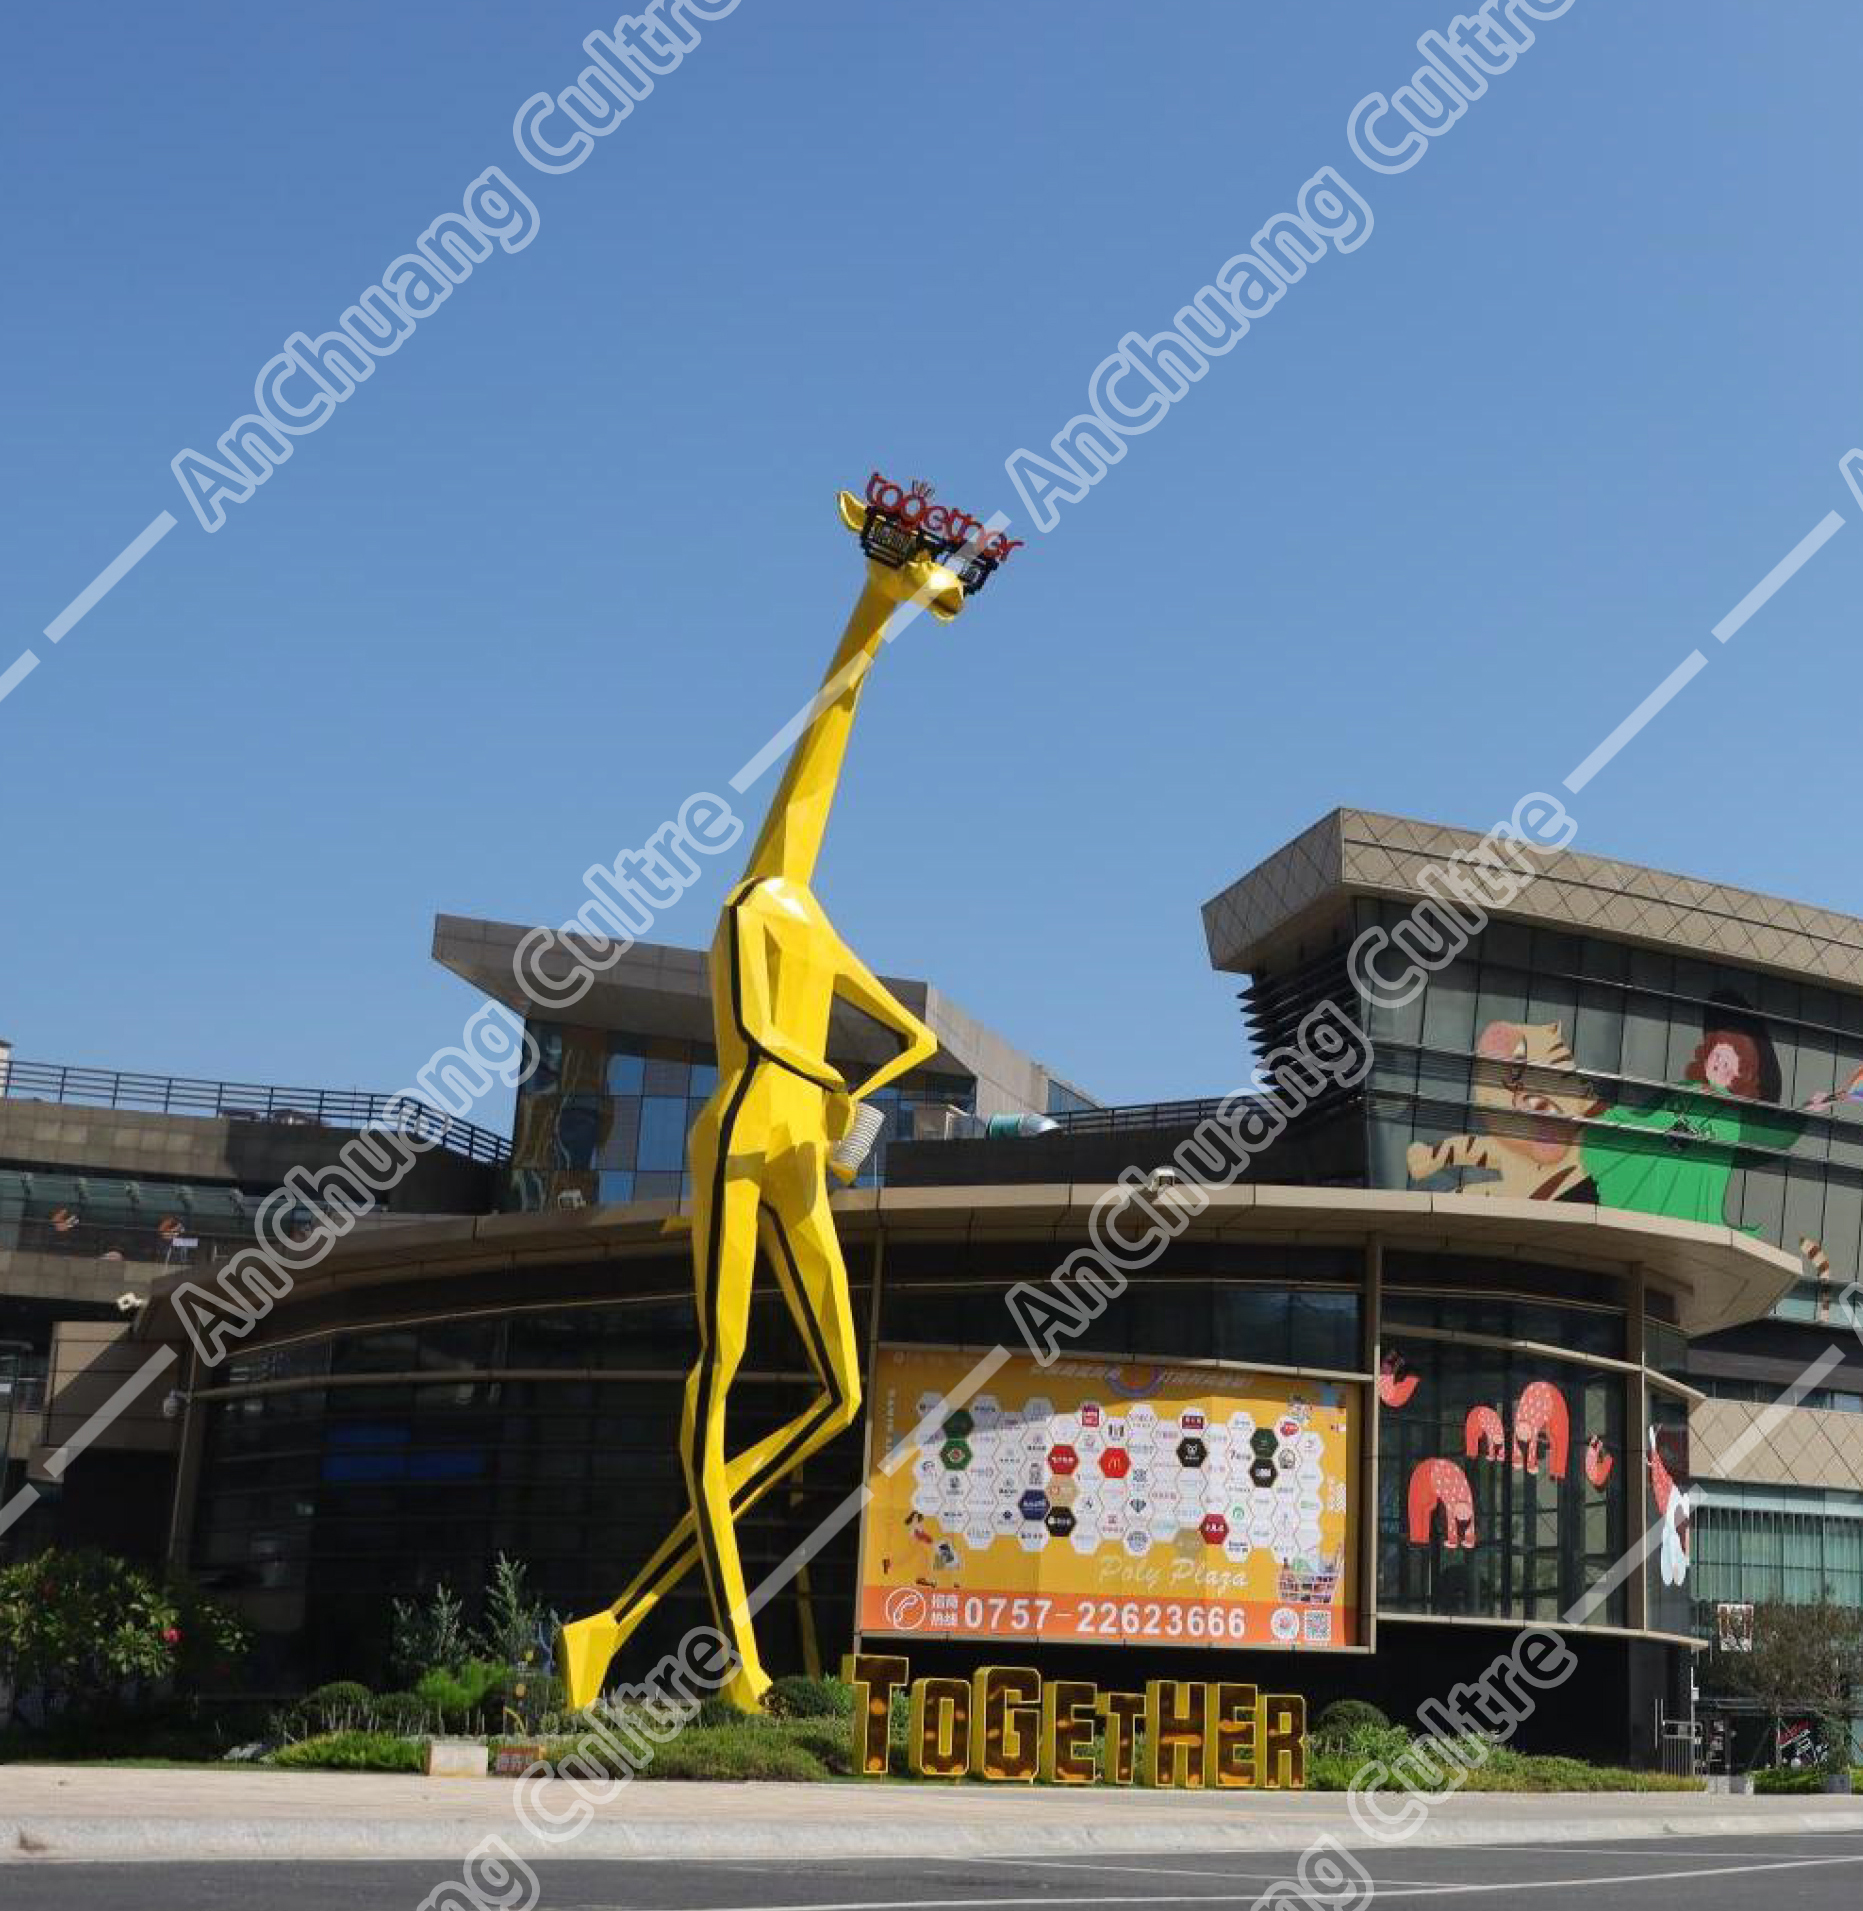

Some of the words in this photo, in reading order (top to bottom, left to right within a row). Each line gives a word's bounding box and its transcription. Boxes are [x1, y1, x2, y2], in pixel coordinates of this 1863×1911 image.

[866, 472, 1024, 562] together
[1098, 1555, 1163, 1589] Poly
[1168, 1557, 1249, 1597] Plaza
